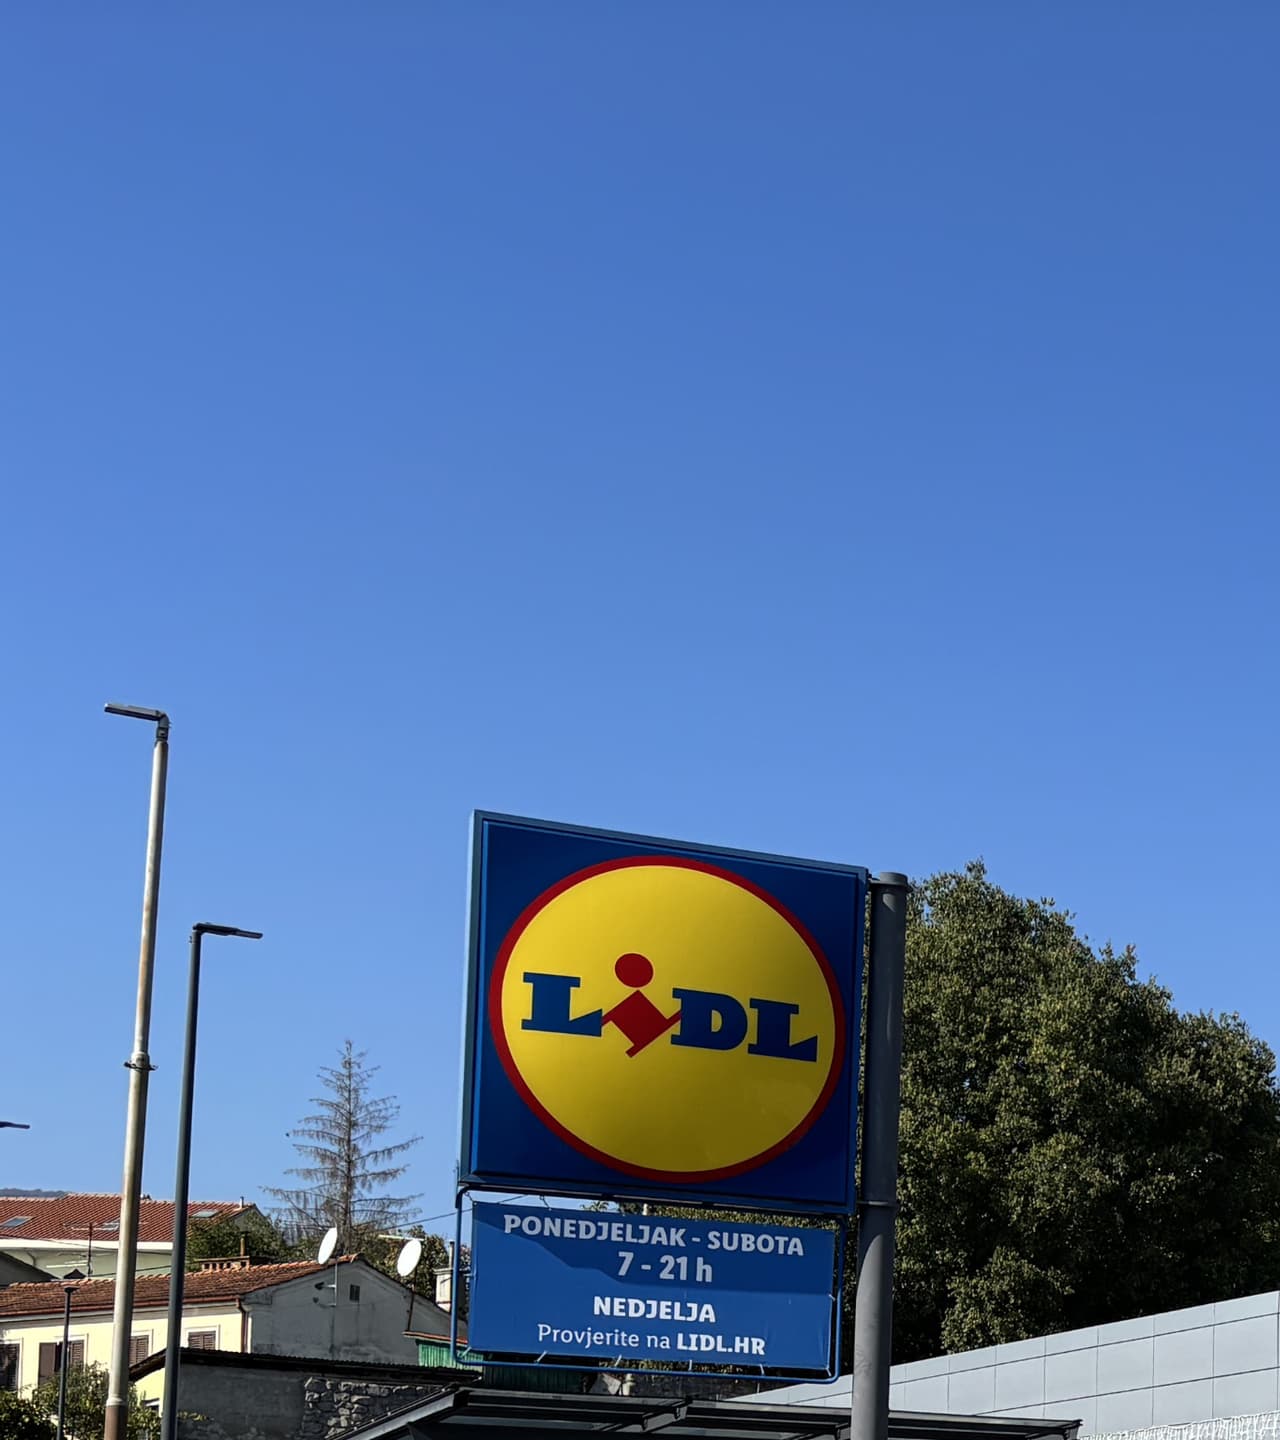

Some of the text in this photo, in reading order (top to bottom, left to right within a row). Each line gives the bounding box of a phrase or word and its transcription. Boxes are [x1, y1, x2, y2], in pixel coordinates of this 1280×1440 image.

[503, 1213, 687, 1248] PONEDJELJAK
[707, 1230, 805, 1256] SUBOTA
[617, 1251, 635, 1277] 7
[659, 1254, 688, 1281] 21
[695, 1256, 713, 1282] h
[592, 1295, 717, 1323] NEDJELJA
[536, 1323, 766, 1355] Provjerite na LIDL.HR
